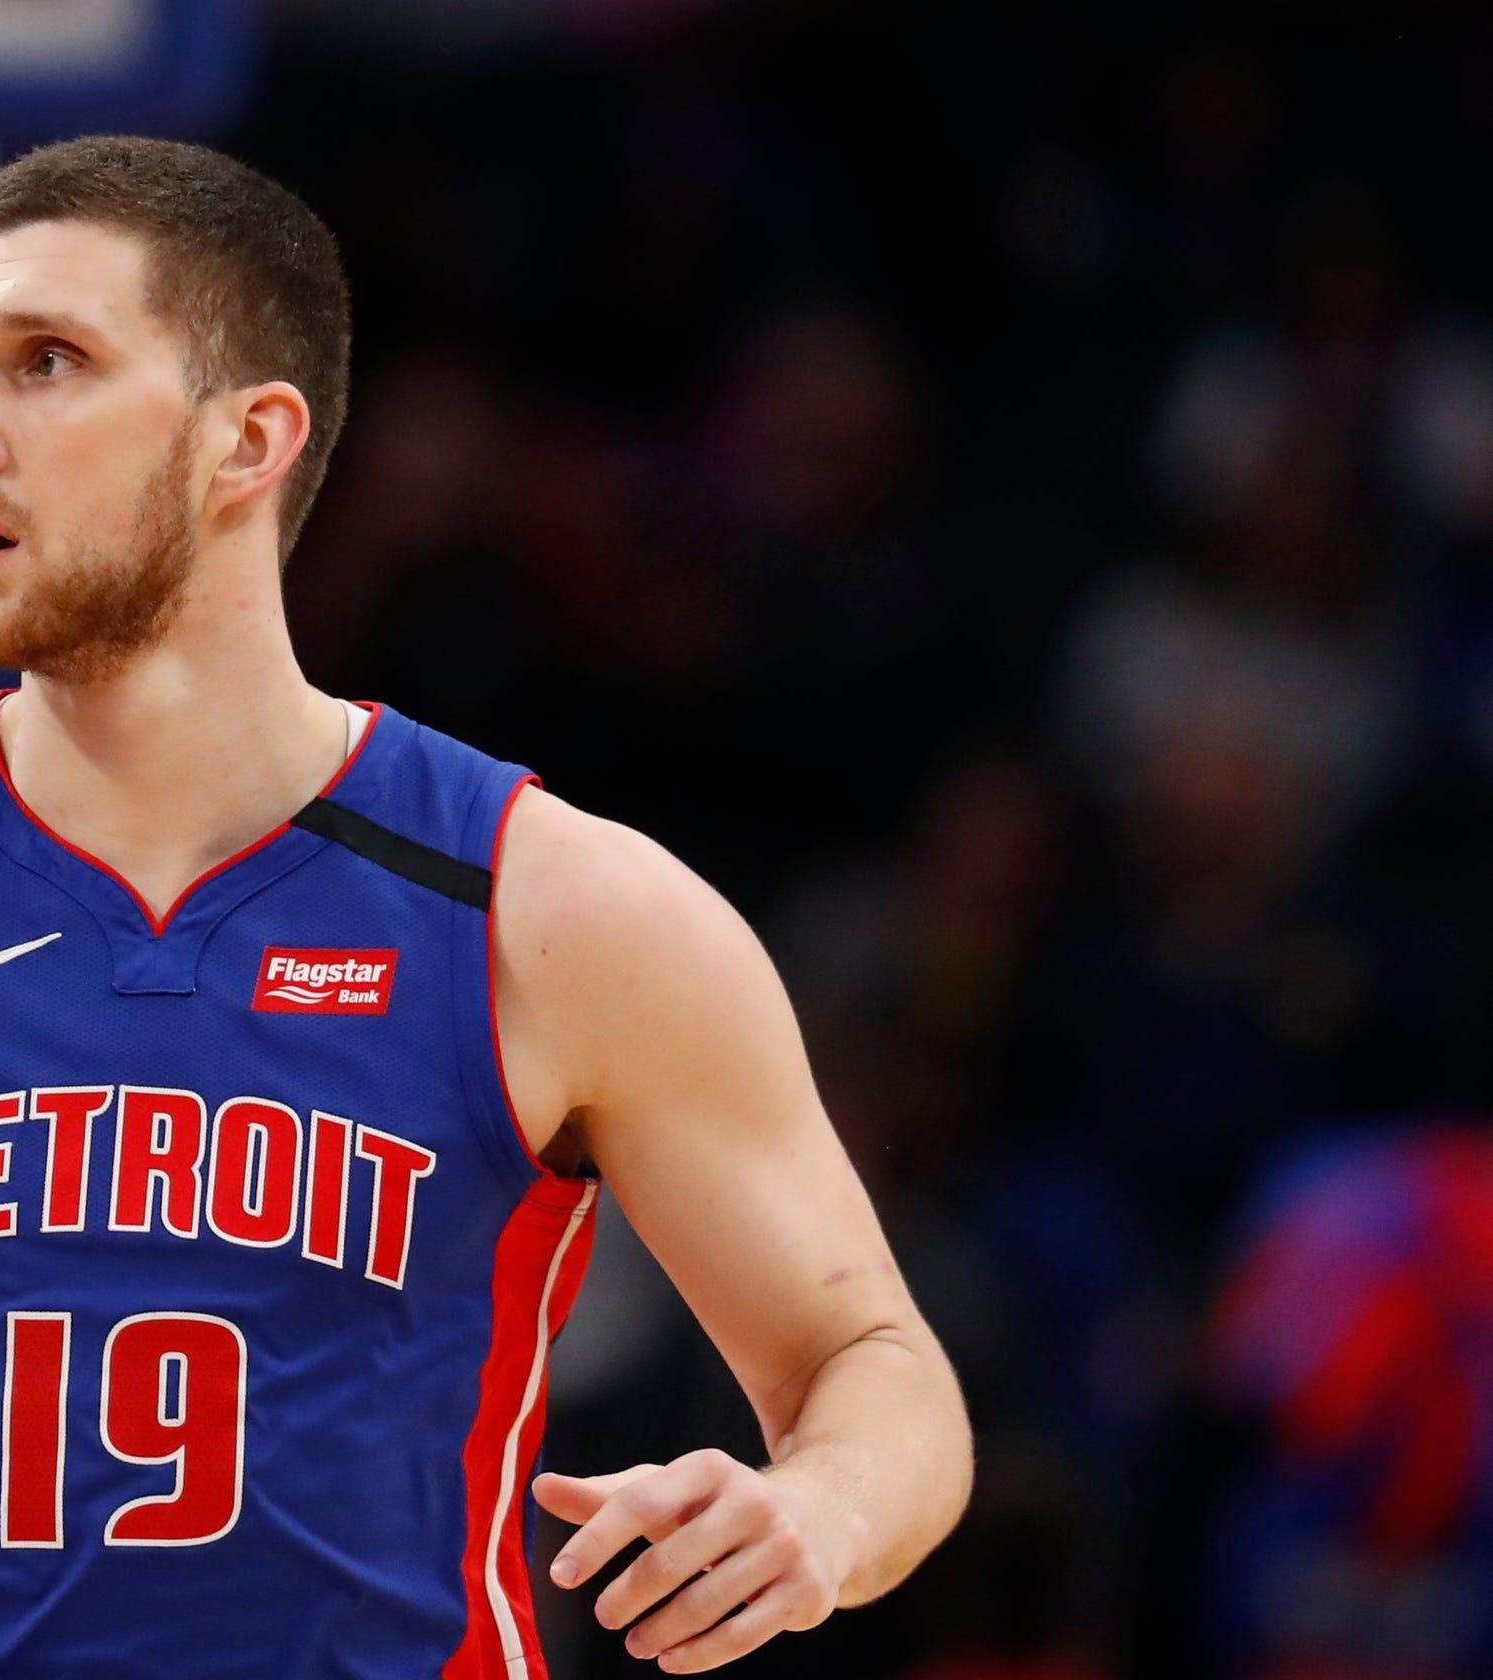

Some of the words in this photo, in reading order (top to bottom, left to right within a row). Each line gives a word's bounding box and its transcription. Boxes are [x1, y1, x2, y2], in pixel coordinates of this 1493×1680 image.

[267, 957, 387, 987] Flagstar
[338, 989, 380, 1003] Bank
[0, 1311, 247, 1549] 19
